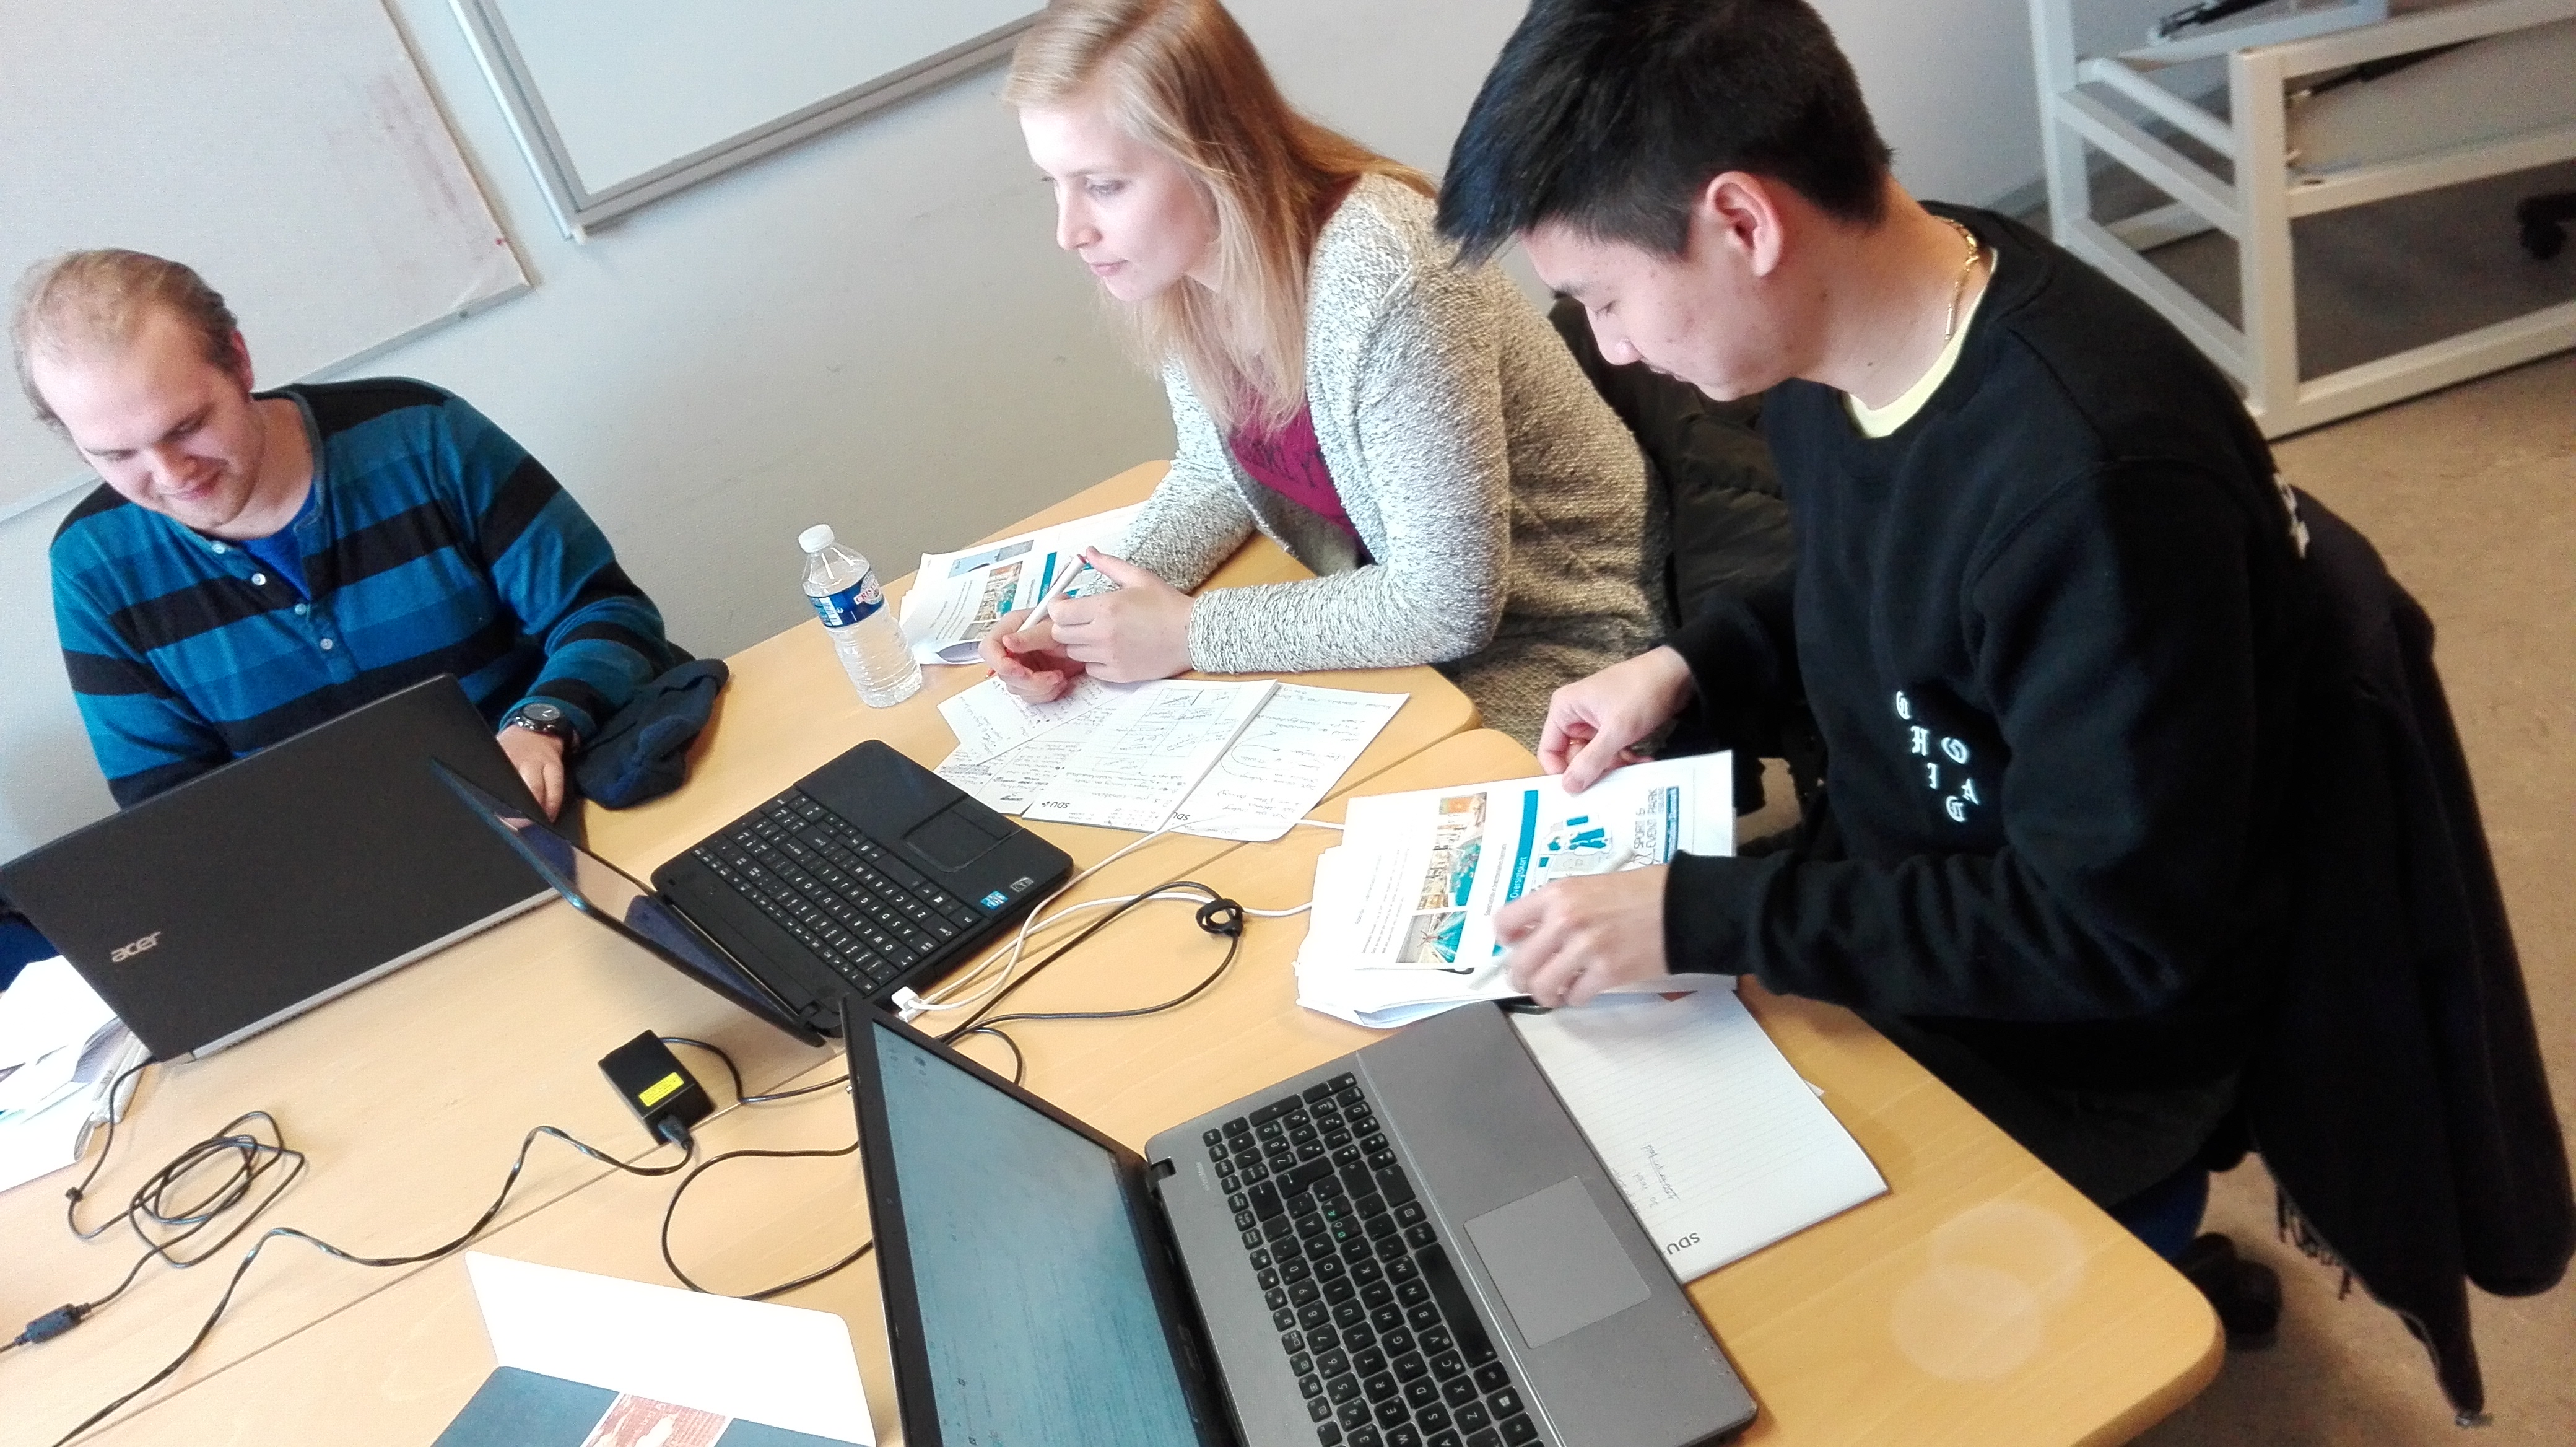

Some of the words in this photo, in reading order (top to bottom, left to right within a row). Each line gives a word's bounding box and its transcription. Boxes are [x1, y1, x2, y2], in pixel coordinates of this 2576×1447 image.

[1647, 788, 1658, 815] PARK
[1172, 811, 1191, 821] SDU
[1634, 821, 1645, 849] SPORT
[1646, 819, 1657, 849] EVENT
[1510, 856, 1528, 898] Oversigtskort
[111, 931, 160, 962] acer
[1666, 1232, 1701, 1255] SDU
[1323, 1263, 1334, 1271] O
[1396, 1263, 1406, 1272] M
[1343, 1308, 1353, 1316] U
[1382, 1312, 1392, 1320] H
[1393, 1336, 1403, 1344] G
[1442, 1359, 1452, 1368] C
[1416, 1386, 1427, 1395] D
[1454, 1385, 1465, 1393] X
[1466, 1412, 1478, 1420] Z
[1397, 1434, 1408, 1445] W
